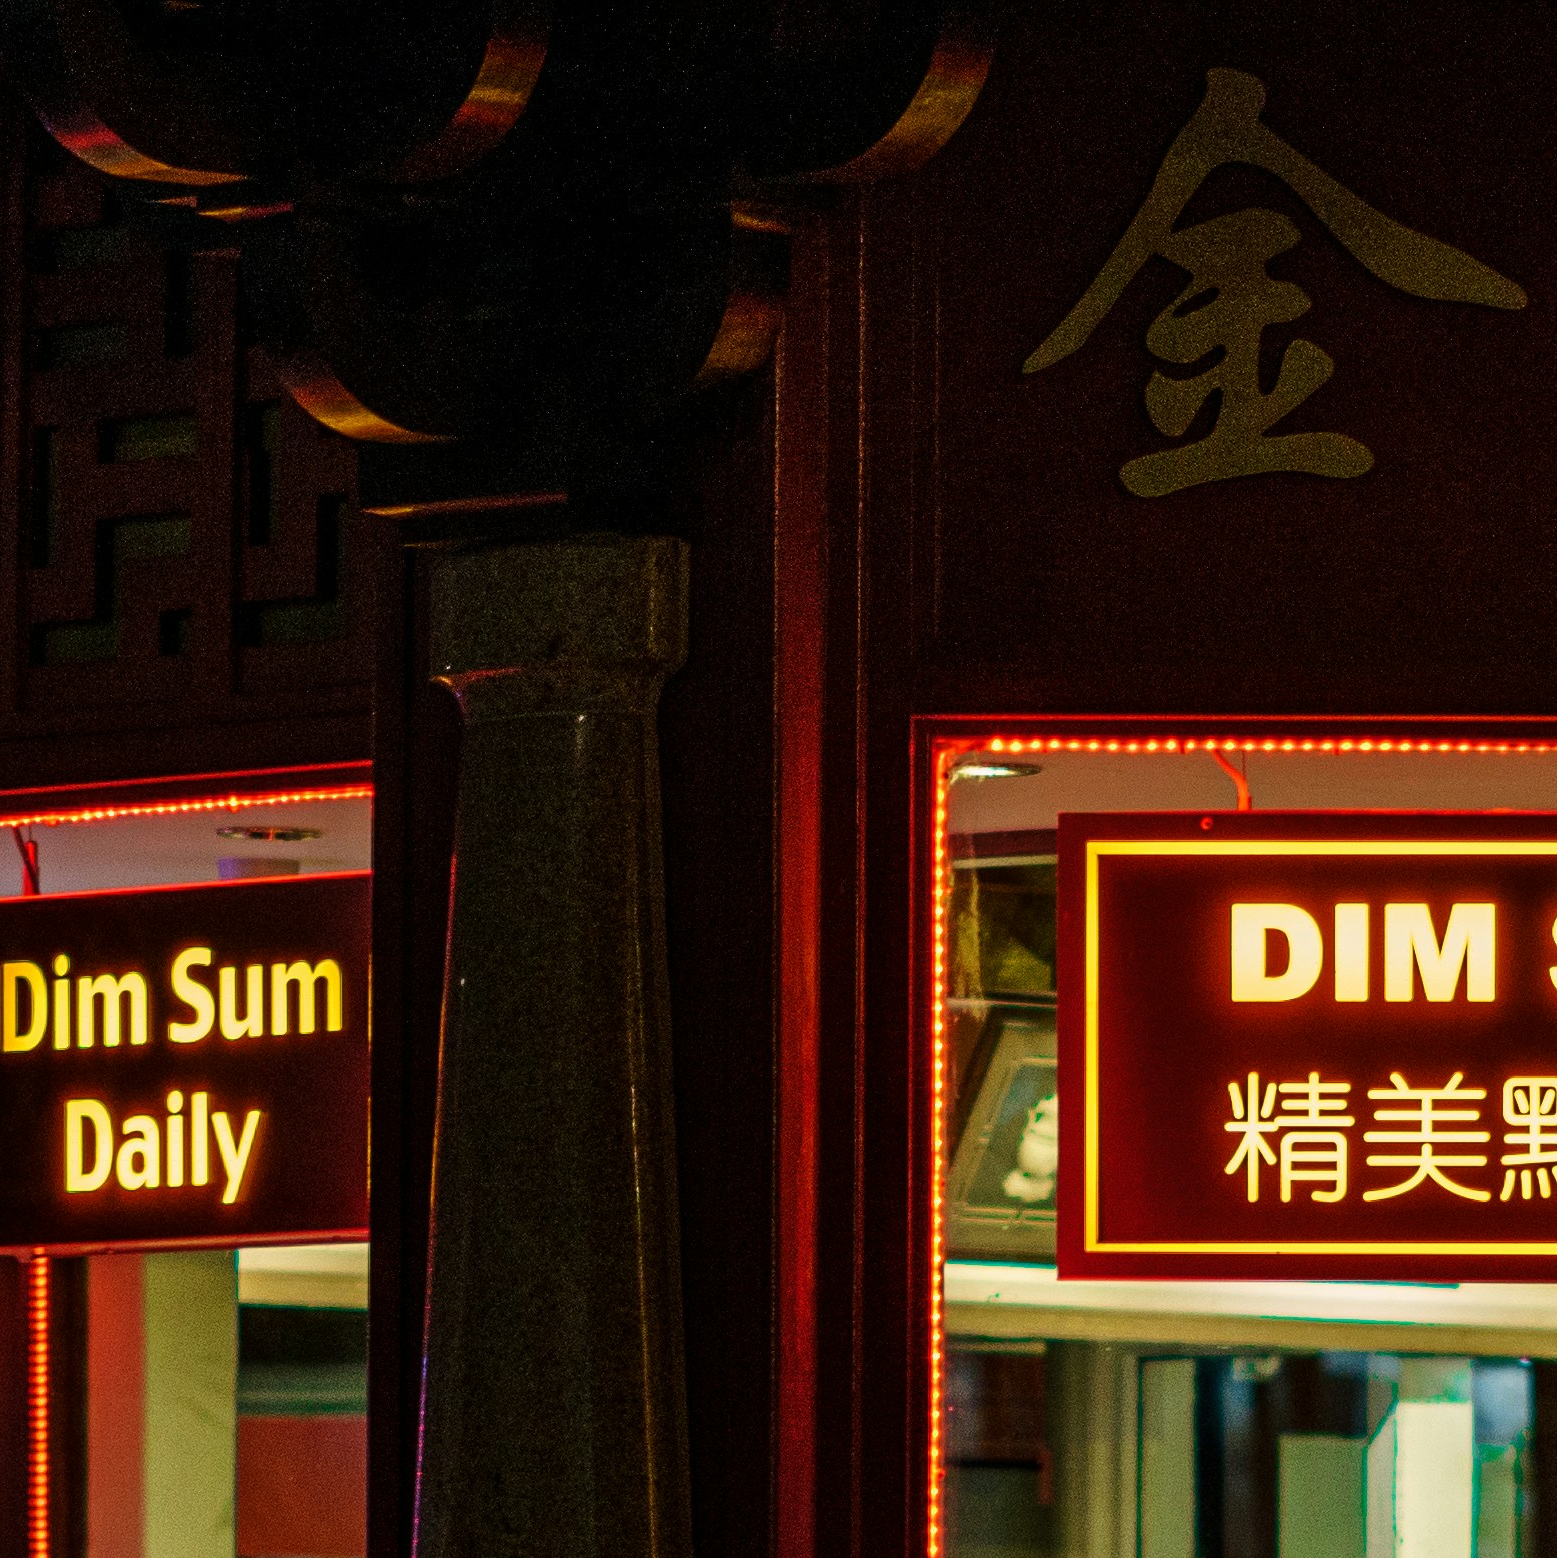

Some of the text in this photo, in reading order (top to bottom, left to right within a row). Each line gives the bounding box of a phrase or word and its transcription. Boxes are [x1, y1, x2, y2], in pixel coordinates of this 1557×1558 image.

[0, 946, 343, 1054] Dim Sum
[1230, 901, 1496, 1003] DIM
[64, 1089, 262, 1205] Daily
